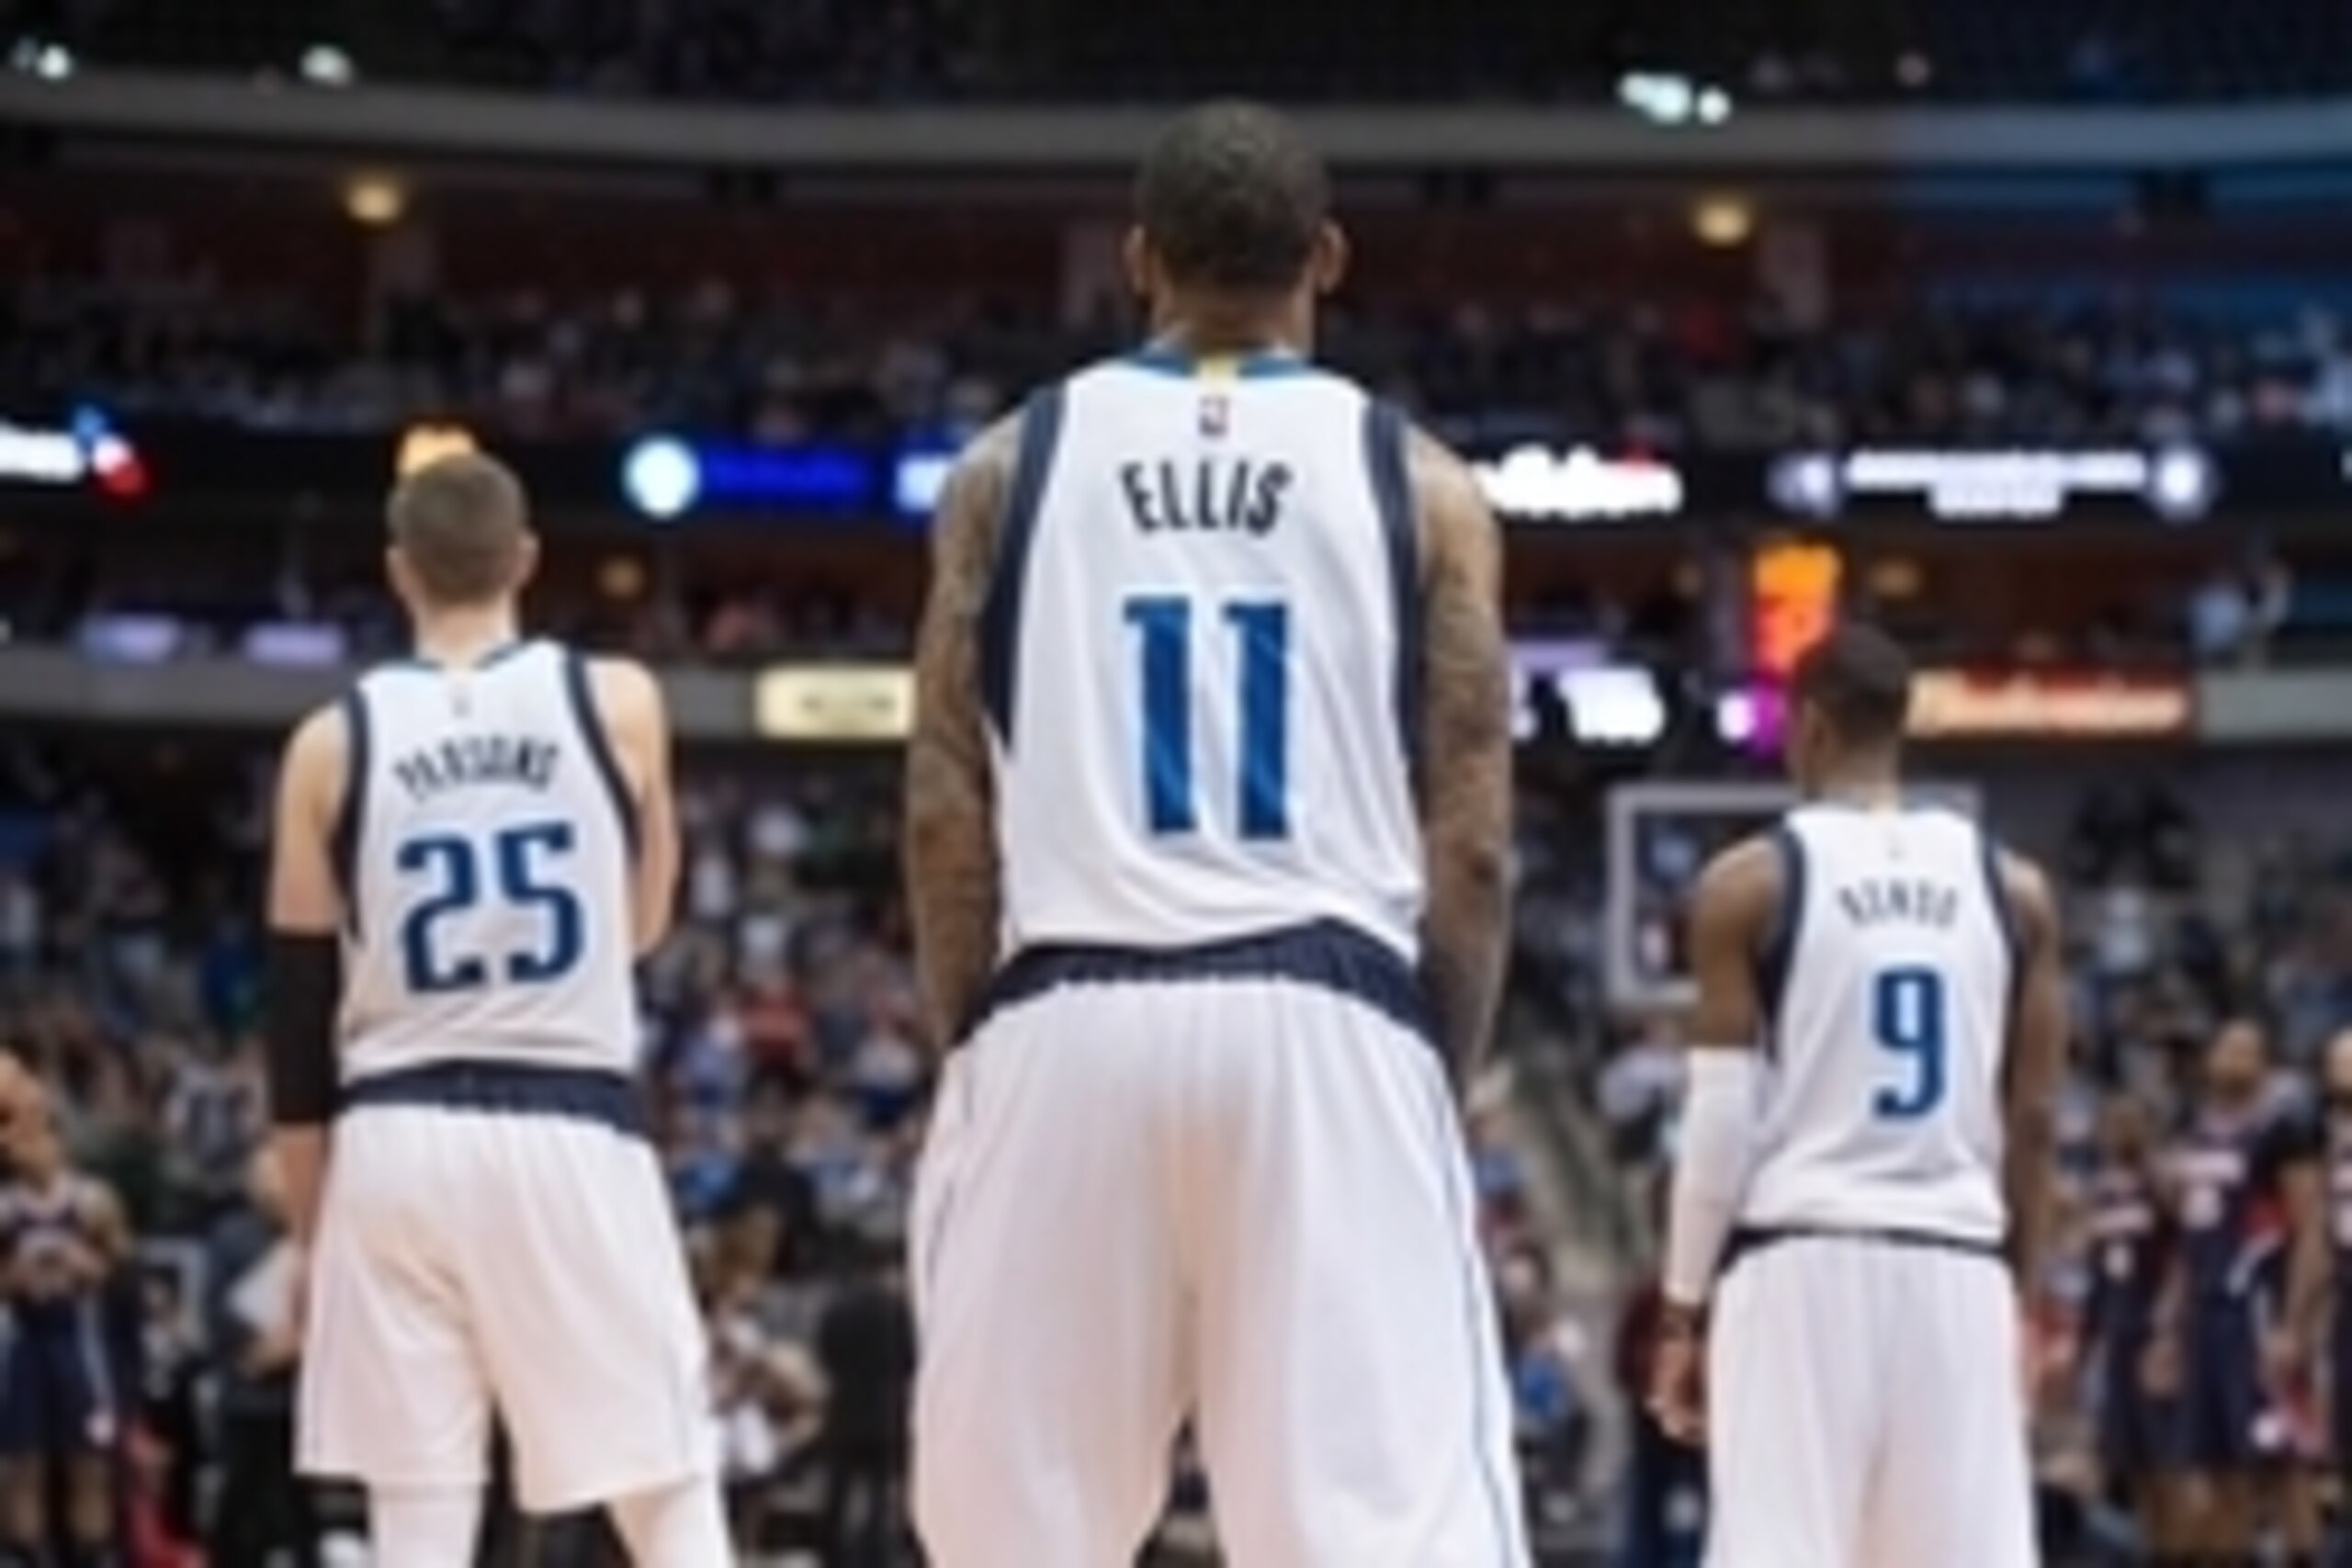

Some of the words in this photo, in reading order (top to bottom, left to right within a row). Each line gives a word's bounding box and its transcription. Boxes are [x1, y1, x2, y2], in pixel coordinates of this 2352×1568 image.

[1121, 460, 1292, 536] ELLIS
[1122, 595, 1291, 842] 11
[395, 823, 584, 994] 25
[1872, 966, 1945, 1119] 9
